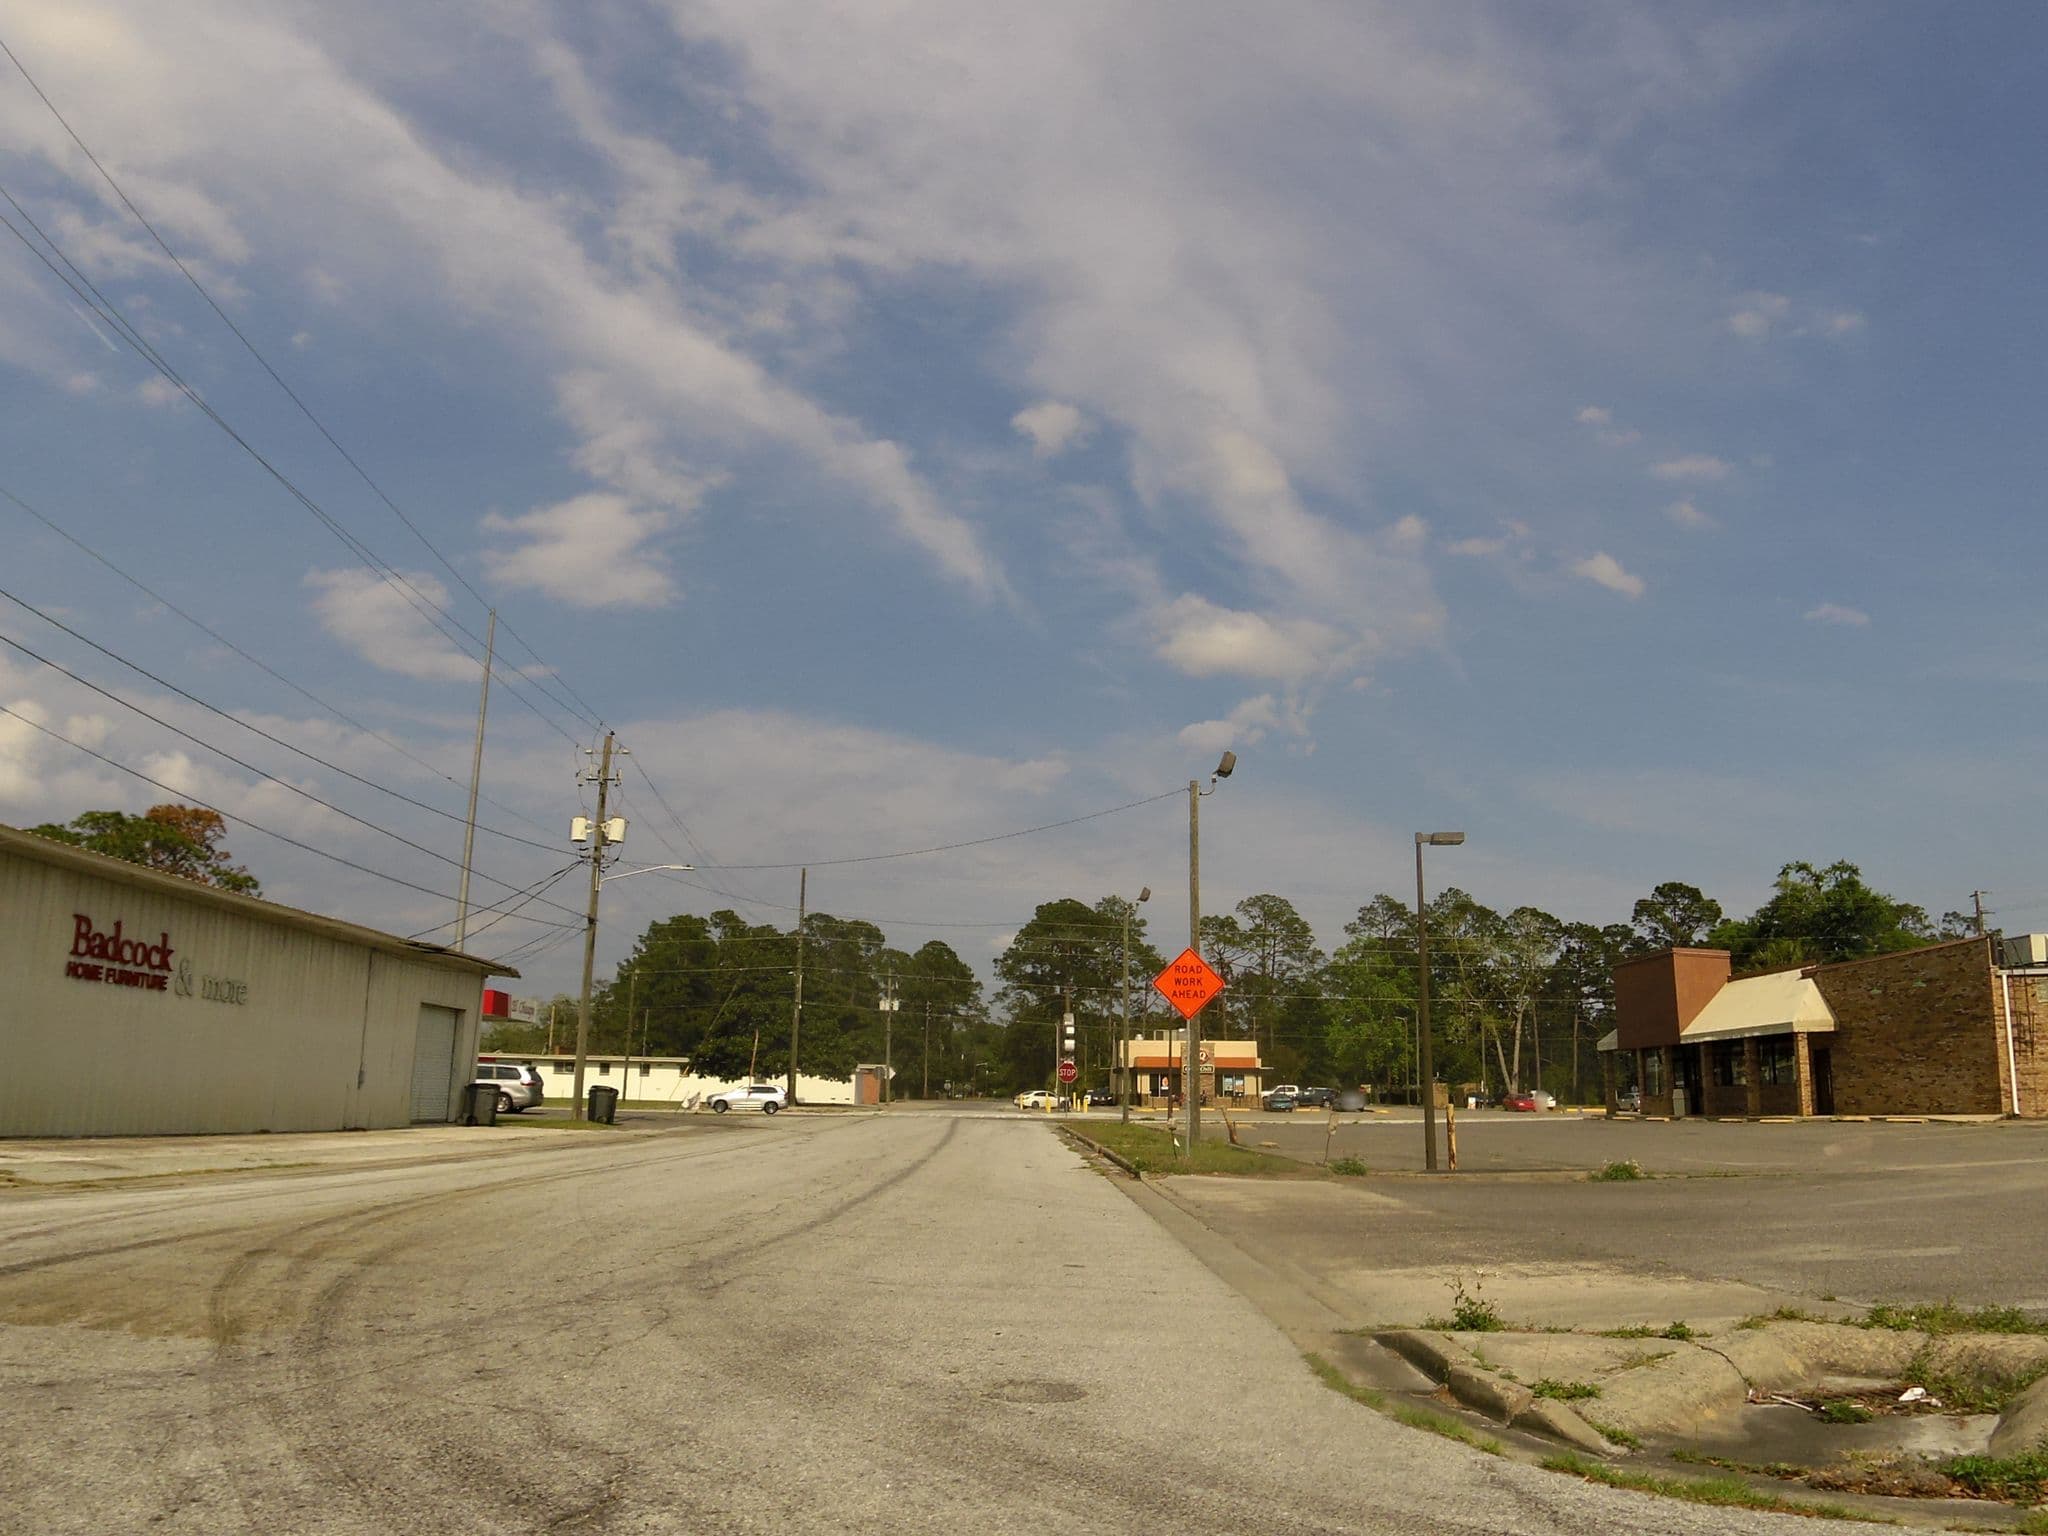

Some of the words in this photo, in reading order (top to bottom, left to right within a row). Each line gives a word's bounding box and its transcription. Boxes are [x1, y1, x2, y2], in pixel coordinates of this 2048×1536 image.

[69, 914, 175, 971] Badcock
[1174, 965, 1203, 974] ROAD
[66, 961, 103, 982] HOME
[105, 967, 169, 991] FURNITURE
[174, 958, 193, 997] &
[201, 975, 248, 1005] more
[1174, 977, 1203, 986] WORK
[1171, 989, 1206, 999] AHEAD
[1059, 1068, 1076, 1076] STOP
